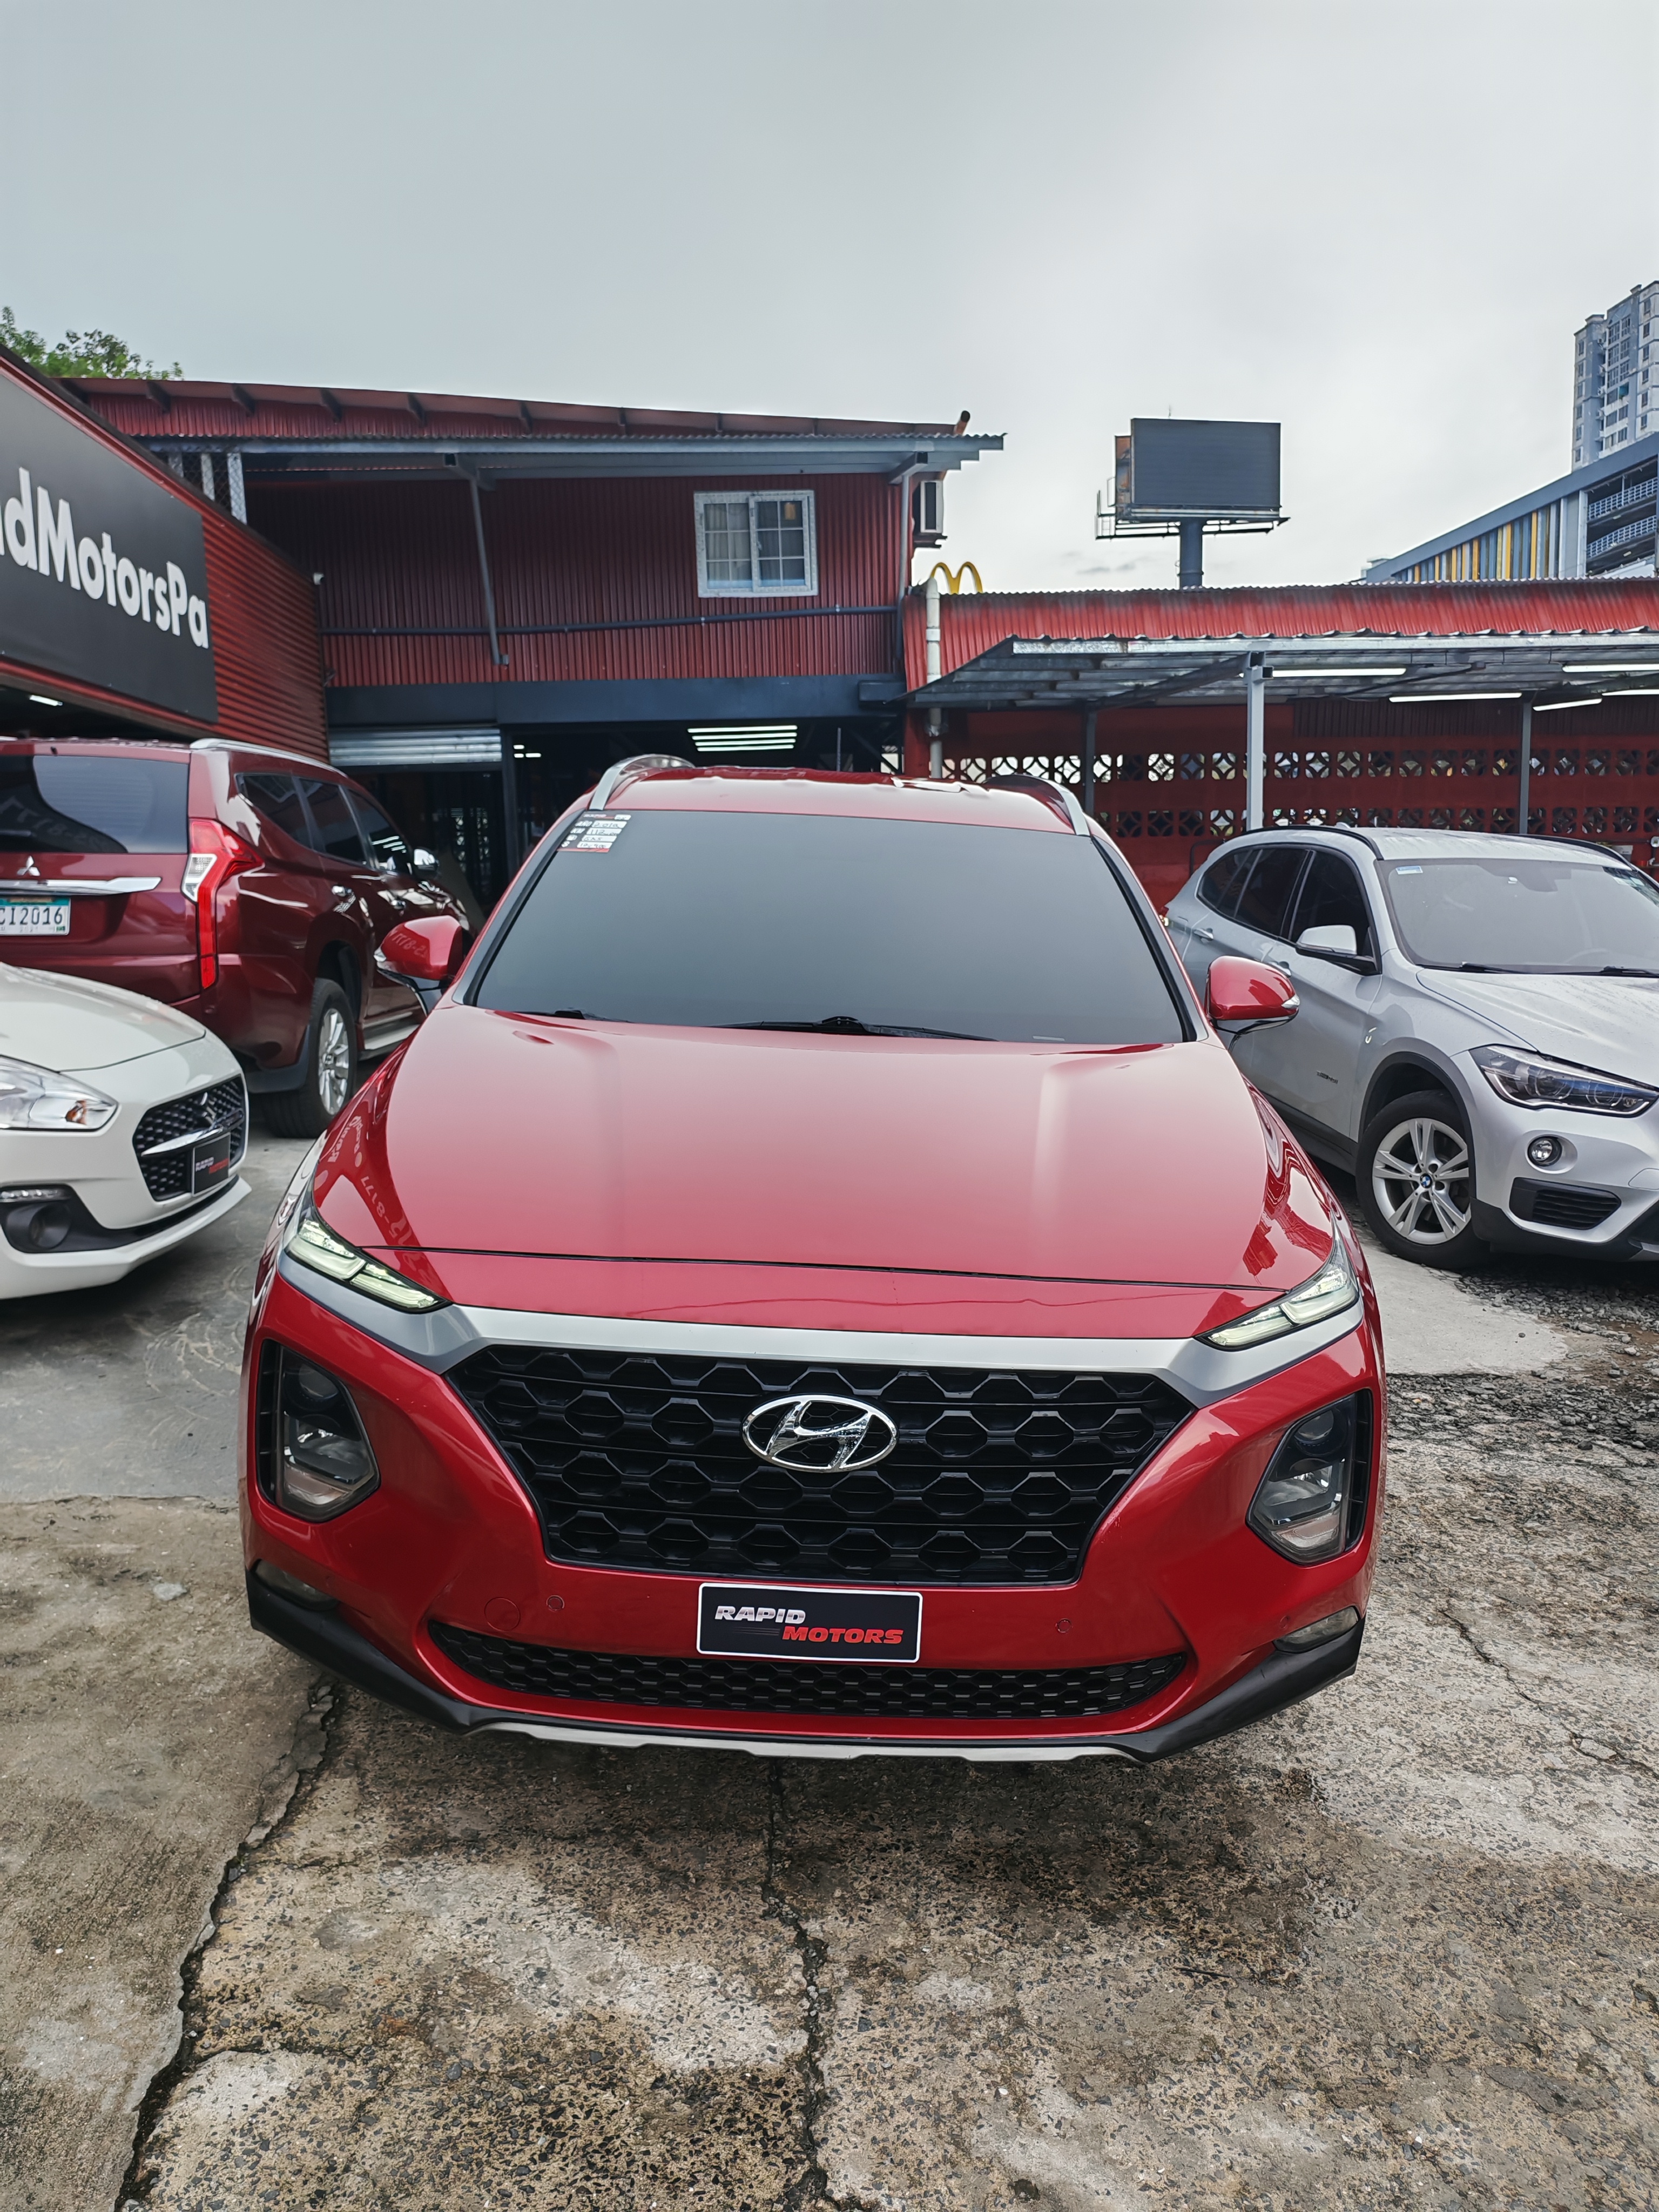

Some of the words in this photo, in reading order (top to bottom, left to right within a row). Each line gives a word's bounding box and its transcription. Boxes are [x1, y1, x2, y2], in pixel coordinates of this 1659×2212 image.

[0, 467, 208, 649] dMotorsPa
[714, 1606, 806, 1624] RAPID
[782, 1626, 903, 1644] MOTORS
